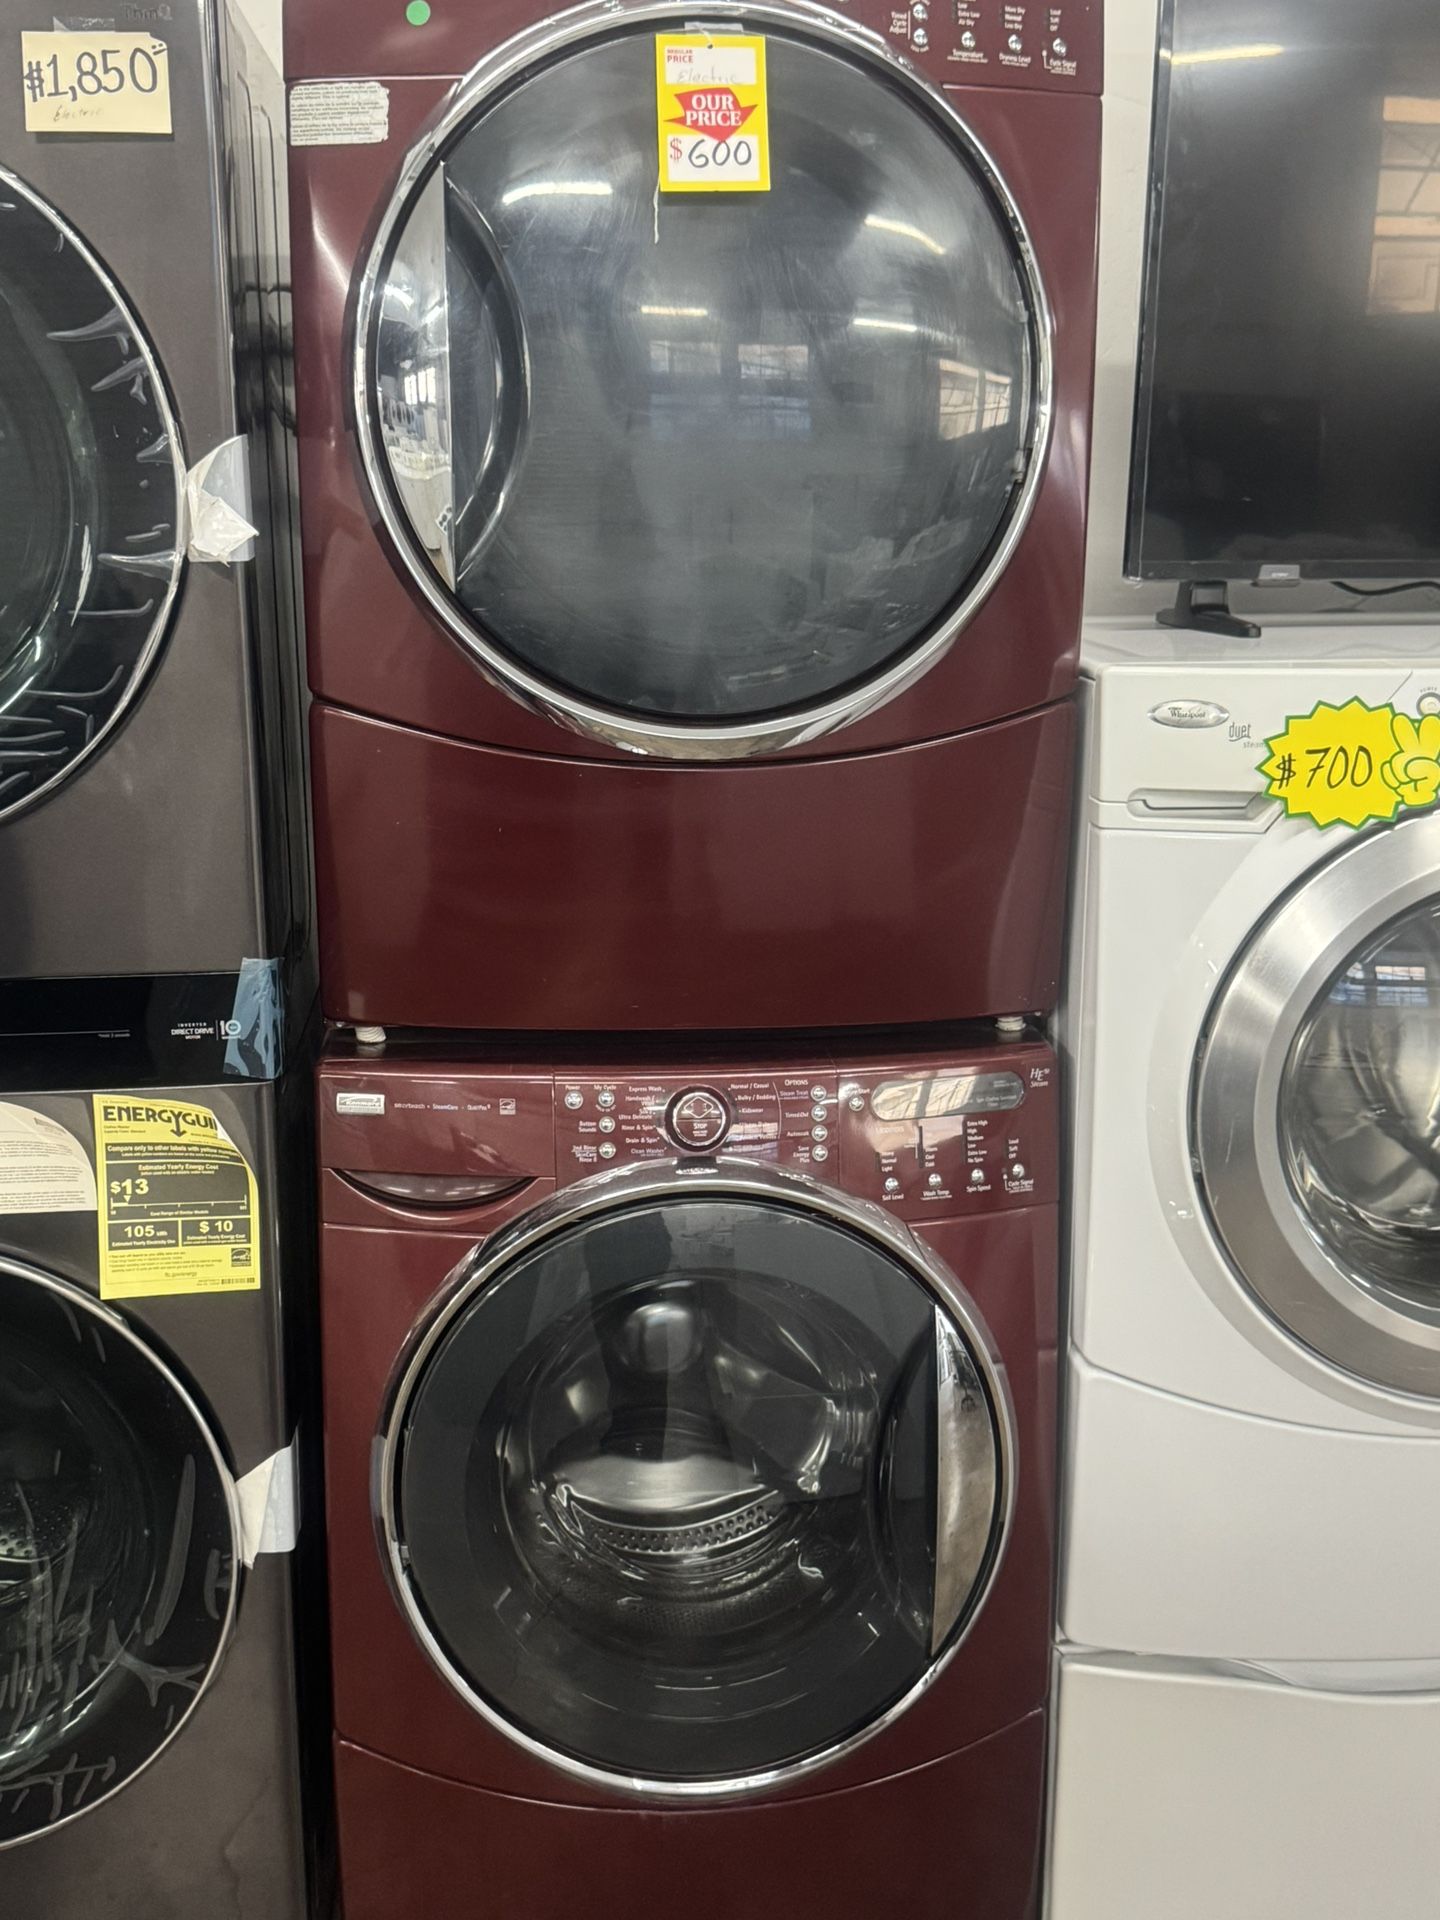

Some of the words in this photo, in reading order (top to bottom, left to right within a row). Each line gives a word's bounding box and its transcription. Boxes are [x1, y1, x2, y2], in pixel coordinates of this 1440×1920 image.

[667, 55, 694, 63] PRICE
[691, 94, 734, 111] OUR
[685, 110, 742, 126] PRICE
[688, 138, 752, 168] 600
[1169, 707, 1206, 719] Whirlpool
[1305, 745, 1373, 790] 700
[134, 1145, 147, 1153] only
[167, 1163, 184, 1172] Yearly
[185, 1163, 205, 1172] Energy
[110, 1178, 149, 1195] $13
[124, 1224, 155, 1238] 105
[199, 1221, 210, 1233] $
[215, 1220, 233, 1232] 10
